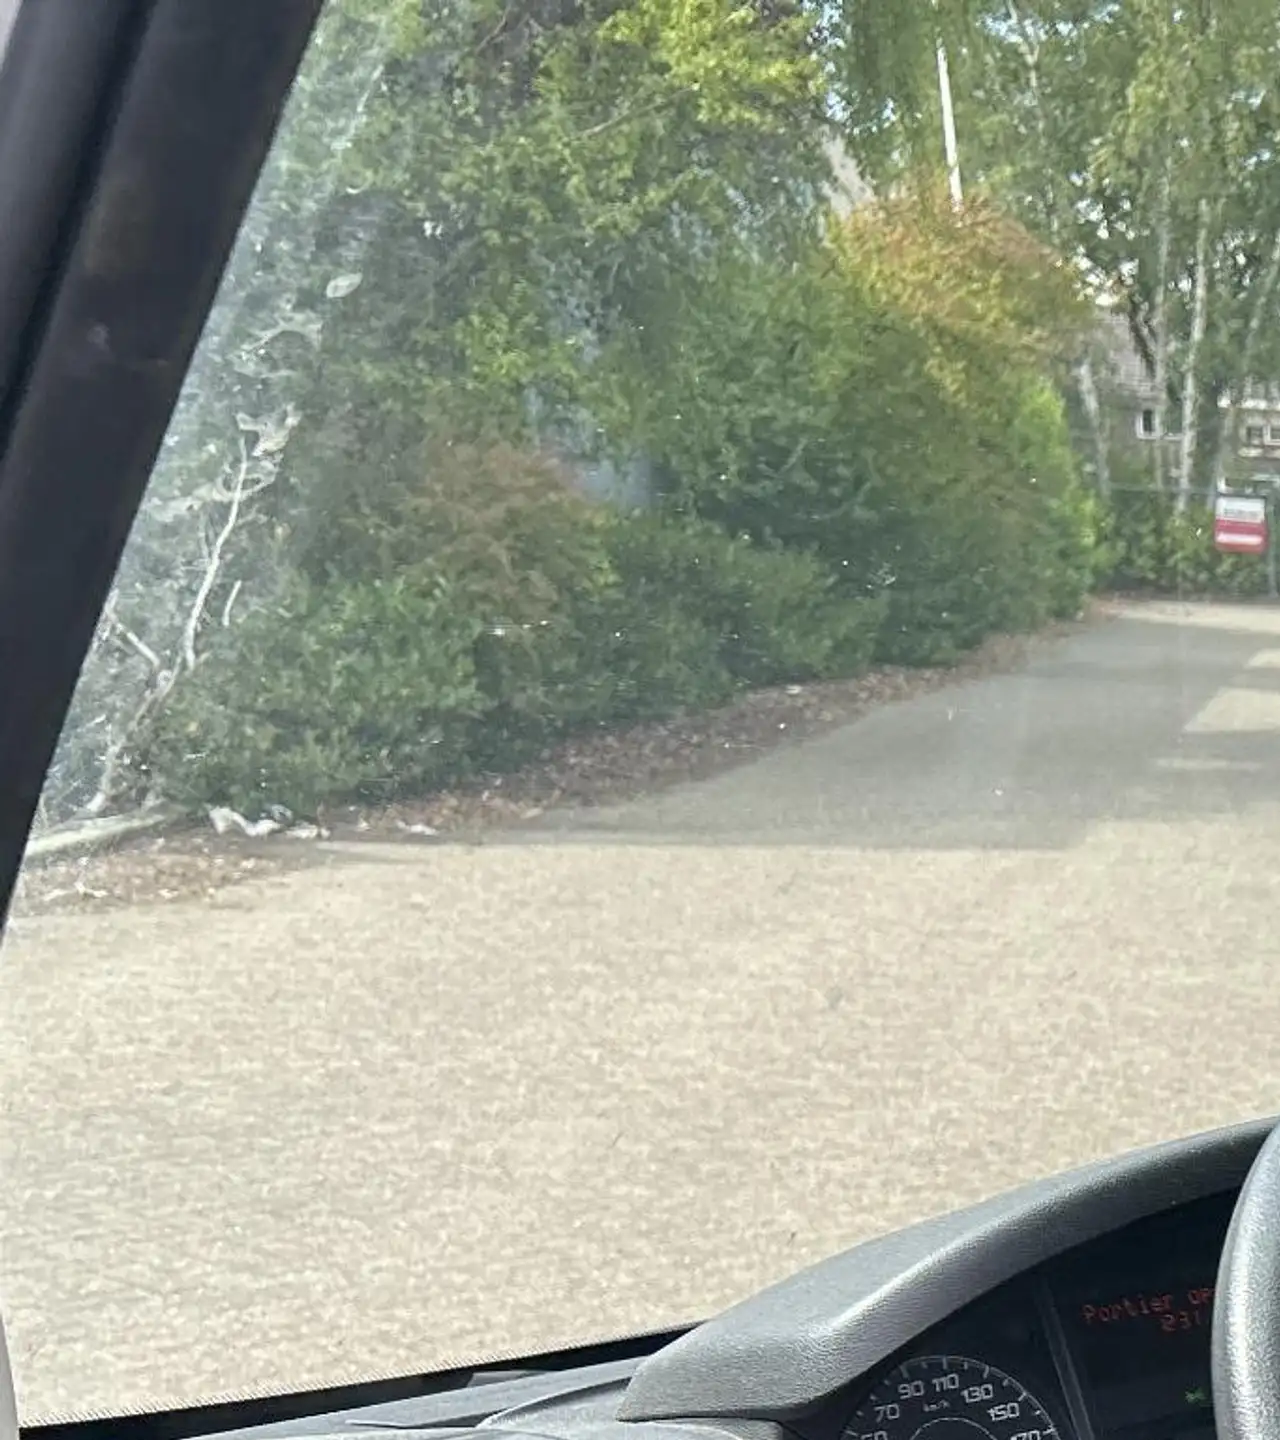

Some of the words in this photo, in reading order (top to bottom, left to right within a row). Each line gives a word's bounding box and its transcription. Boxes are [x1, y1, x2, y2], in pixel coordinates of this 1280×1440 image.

[898, 1380, 925, 1399] 90
[932, 1373, 959, 1392] 110
[960, 1383, 993, 1403] 130
[873, 1403, 900, 1423] 70
[987, 1402, 1020, 1421] 150
